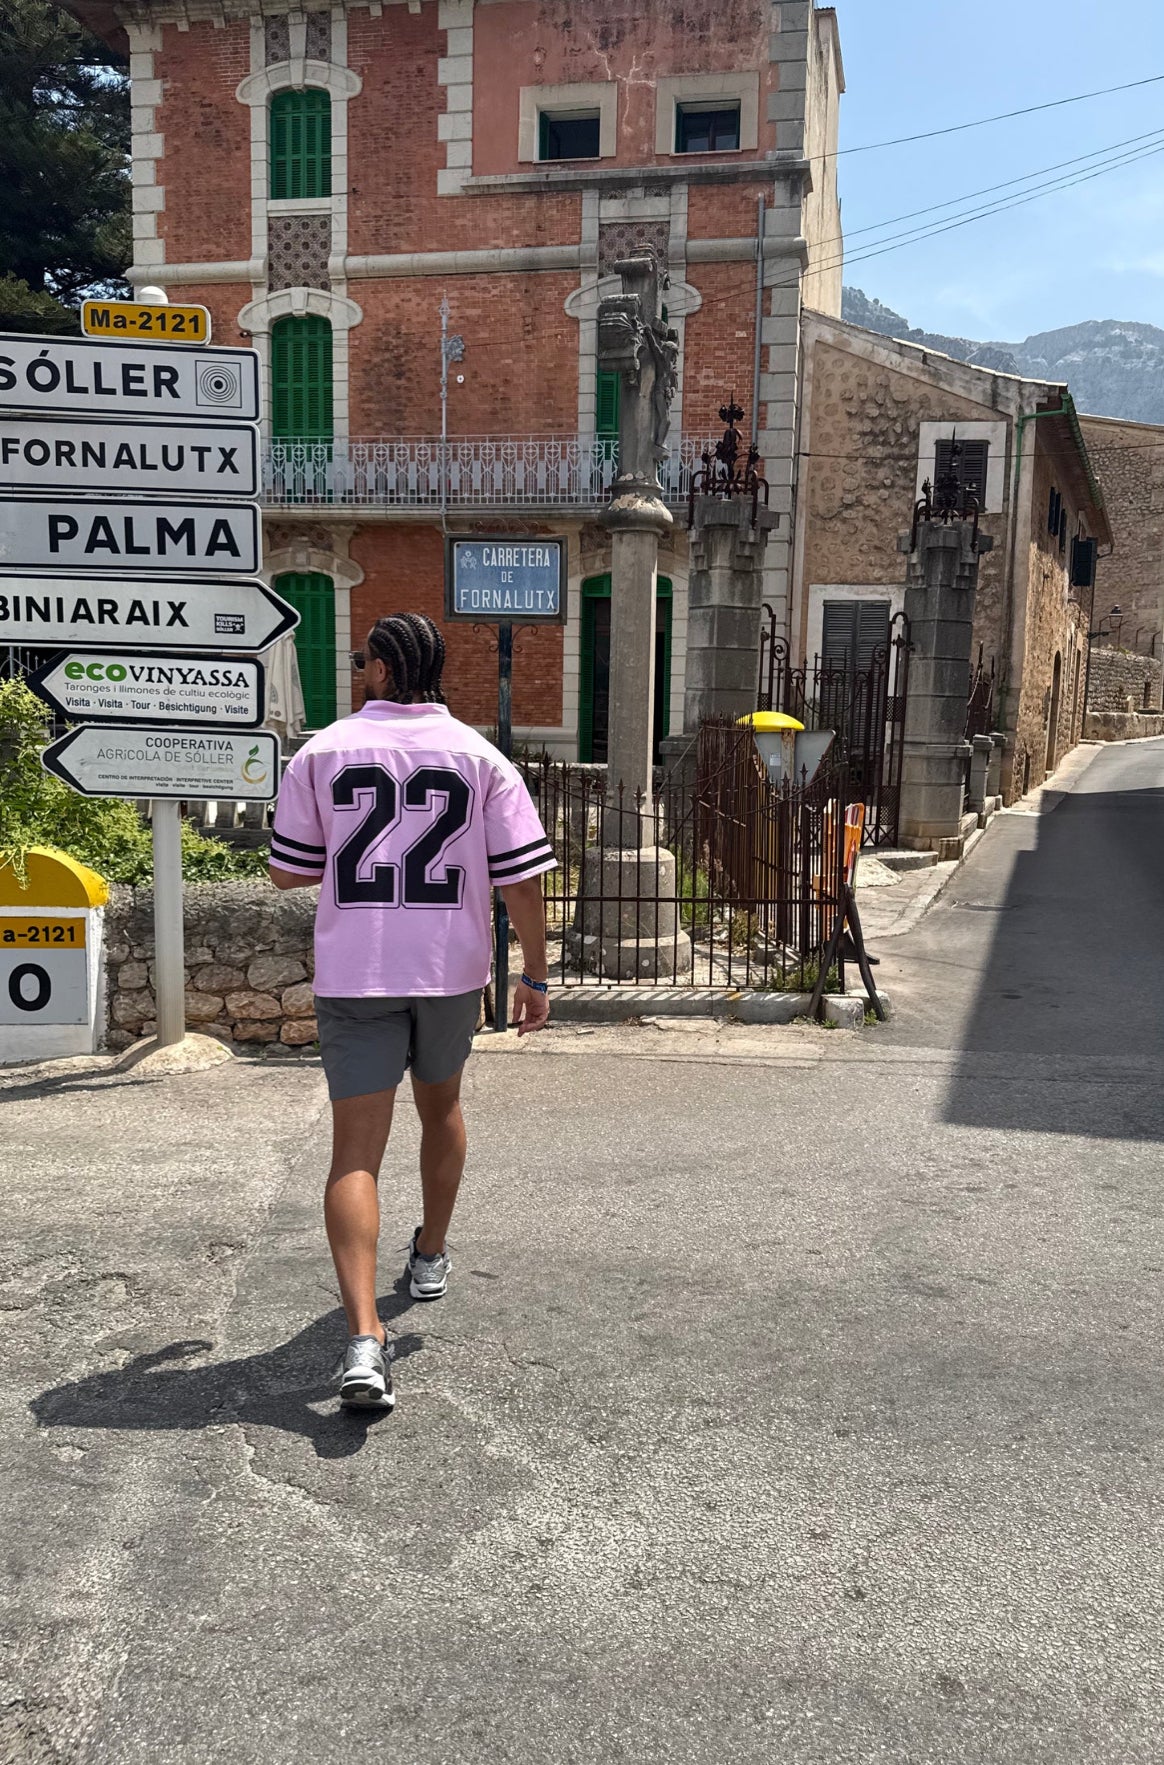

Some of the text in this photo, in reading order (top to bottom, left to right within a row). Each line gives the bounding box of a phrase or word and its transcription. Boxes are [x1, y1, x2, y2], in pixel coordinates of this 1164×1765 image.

[90, 309, 200, 333] Ma-2121
[0, 349, 181, 399] SÓLLER
[1, 437, 240, 474] FORNALUTX
[48, 514, 241, 557] PALMA
[483, 547, 550, 567] CARRETERA
[501, 571, 513, 583] DE
[460, 589, 554, 609] FORNALUTX
[64, 682, 111, 694] Taronges
[119, 686, 160, 696] llimones
[163, 687, 176, 696] de
[179, 688, 206, 698] cultiu
[208, 690, 250, 701] ecològic
[65, 697, 249, 715] Visita Visita Tour Besichtigung Visite
[145, 737, 234, 751] COOPERATIVA
[164, 751, 181, 763] DE
[185, 752, 234, 765] SÓLLER
[330, 763, 475, 909] 22
[3, 925, 75, 942] a-2121
